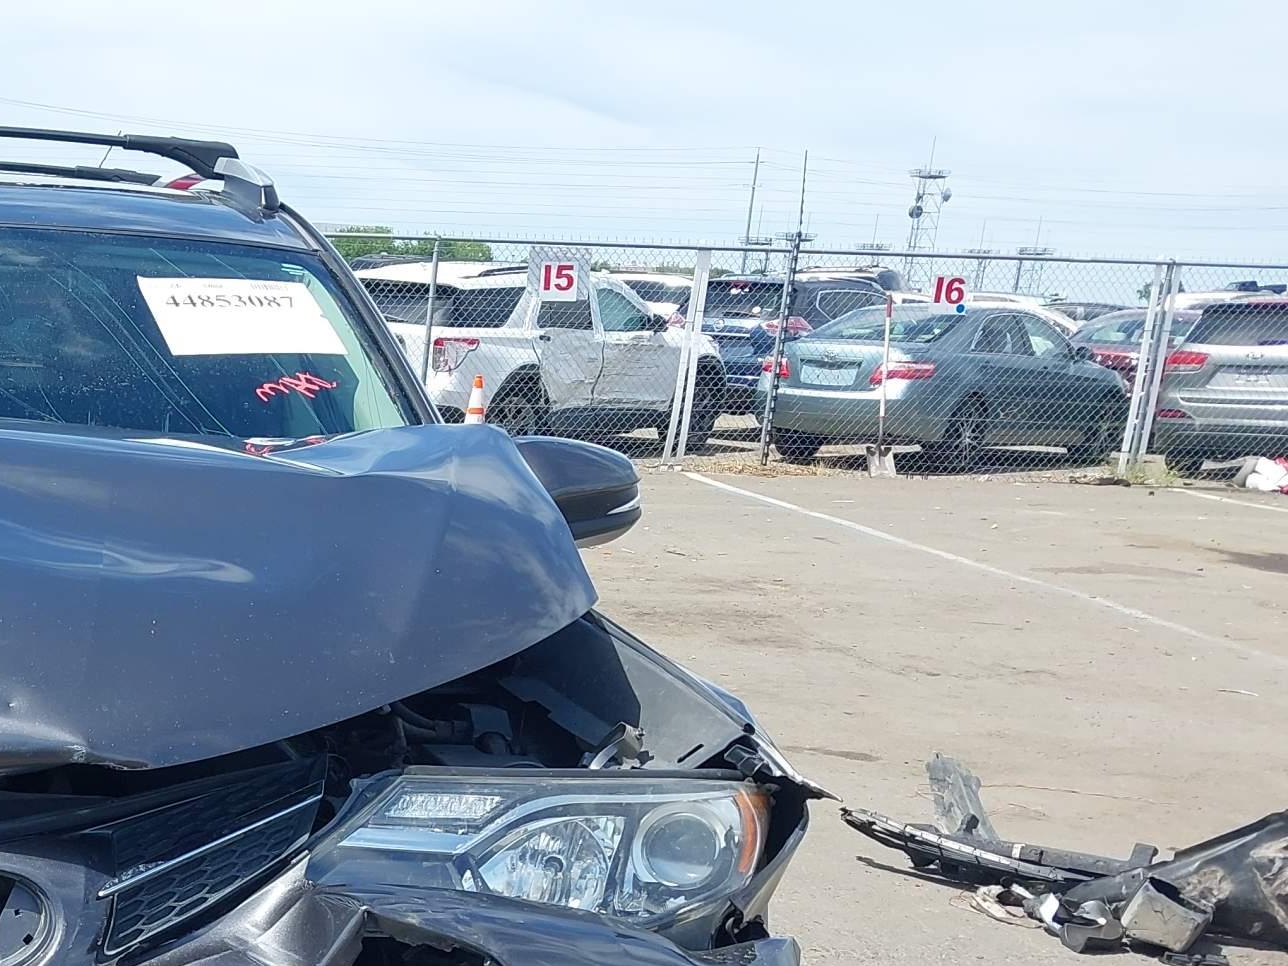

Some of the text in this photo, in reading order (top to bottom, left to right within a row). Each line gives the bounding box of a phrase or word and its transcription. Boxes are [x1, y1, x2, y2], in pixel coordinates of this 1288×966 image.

[543, 264, 574, 291] 15
[933, 276, 966, 305] 16
[165, 294, 294, 308] 44853087
